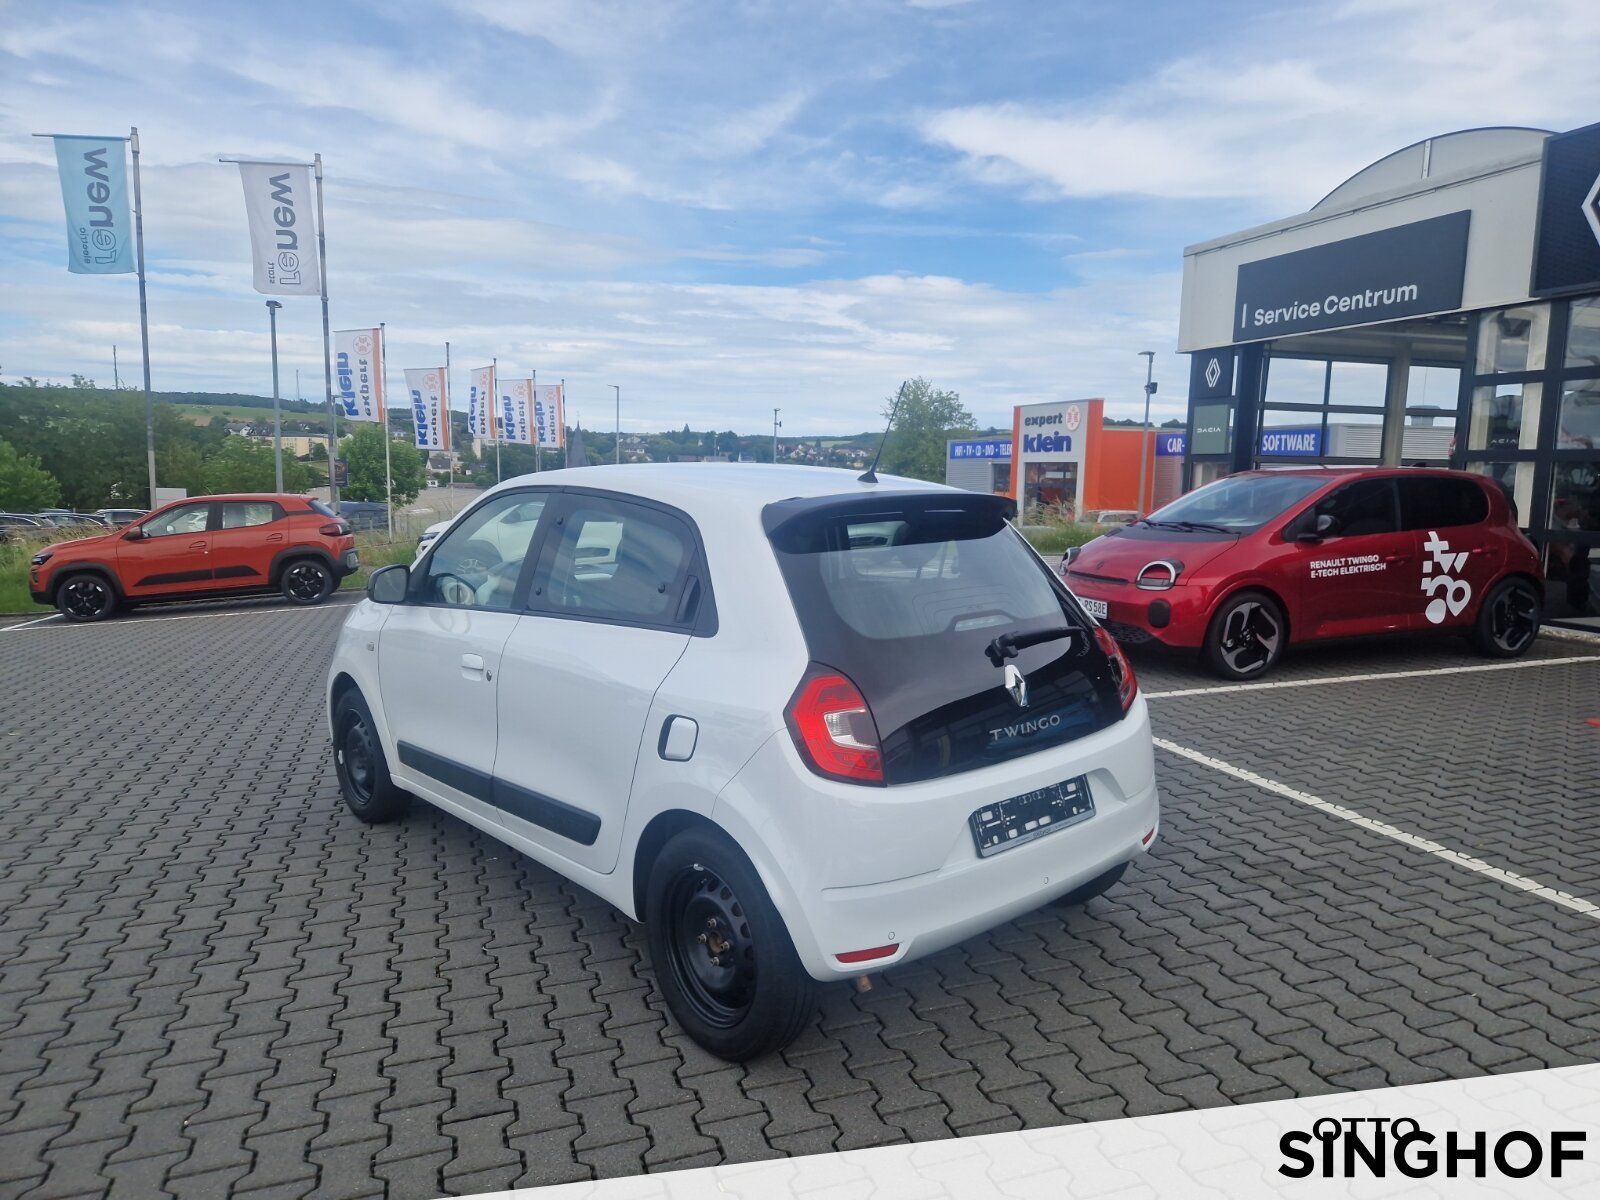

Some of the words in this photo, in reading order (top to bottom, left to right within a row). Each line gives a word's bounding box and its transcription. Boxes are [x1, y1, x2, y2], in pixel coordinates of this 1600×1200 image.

[1253, 301, 1321, 327] Service
[1323, 284, 1418, 315] Centrum
[1024, 413, 1063, 428] expert
[1023, 431, 1072, 453] klein
[1262, 433, 1316, 451] SOFTWARE
[1310, 558, 1346, 569] RENAULT
[1347, 554, 1380, 565] TWINGO
[1310, 568, 1339, 578] E-TECH
[1340, 563, 1387, 575] ELEKTRISCH
[989, 714, 1061, 741] TWINGO
